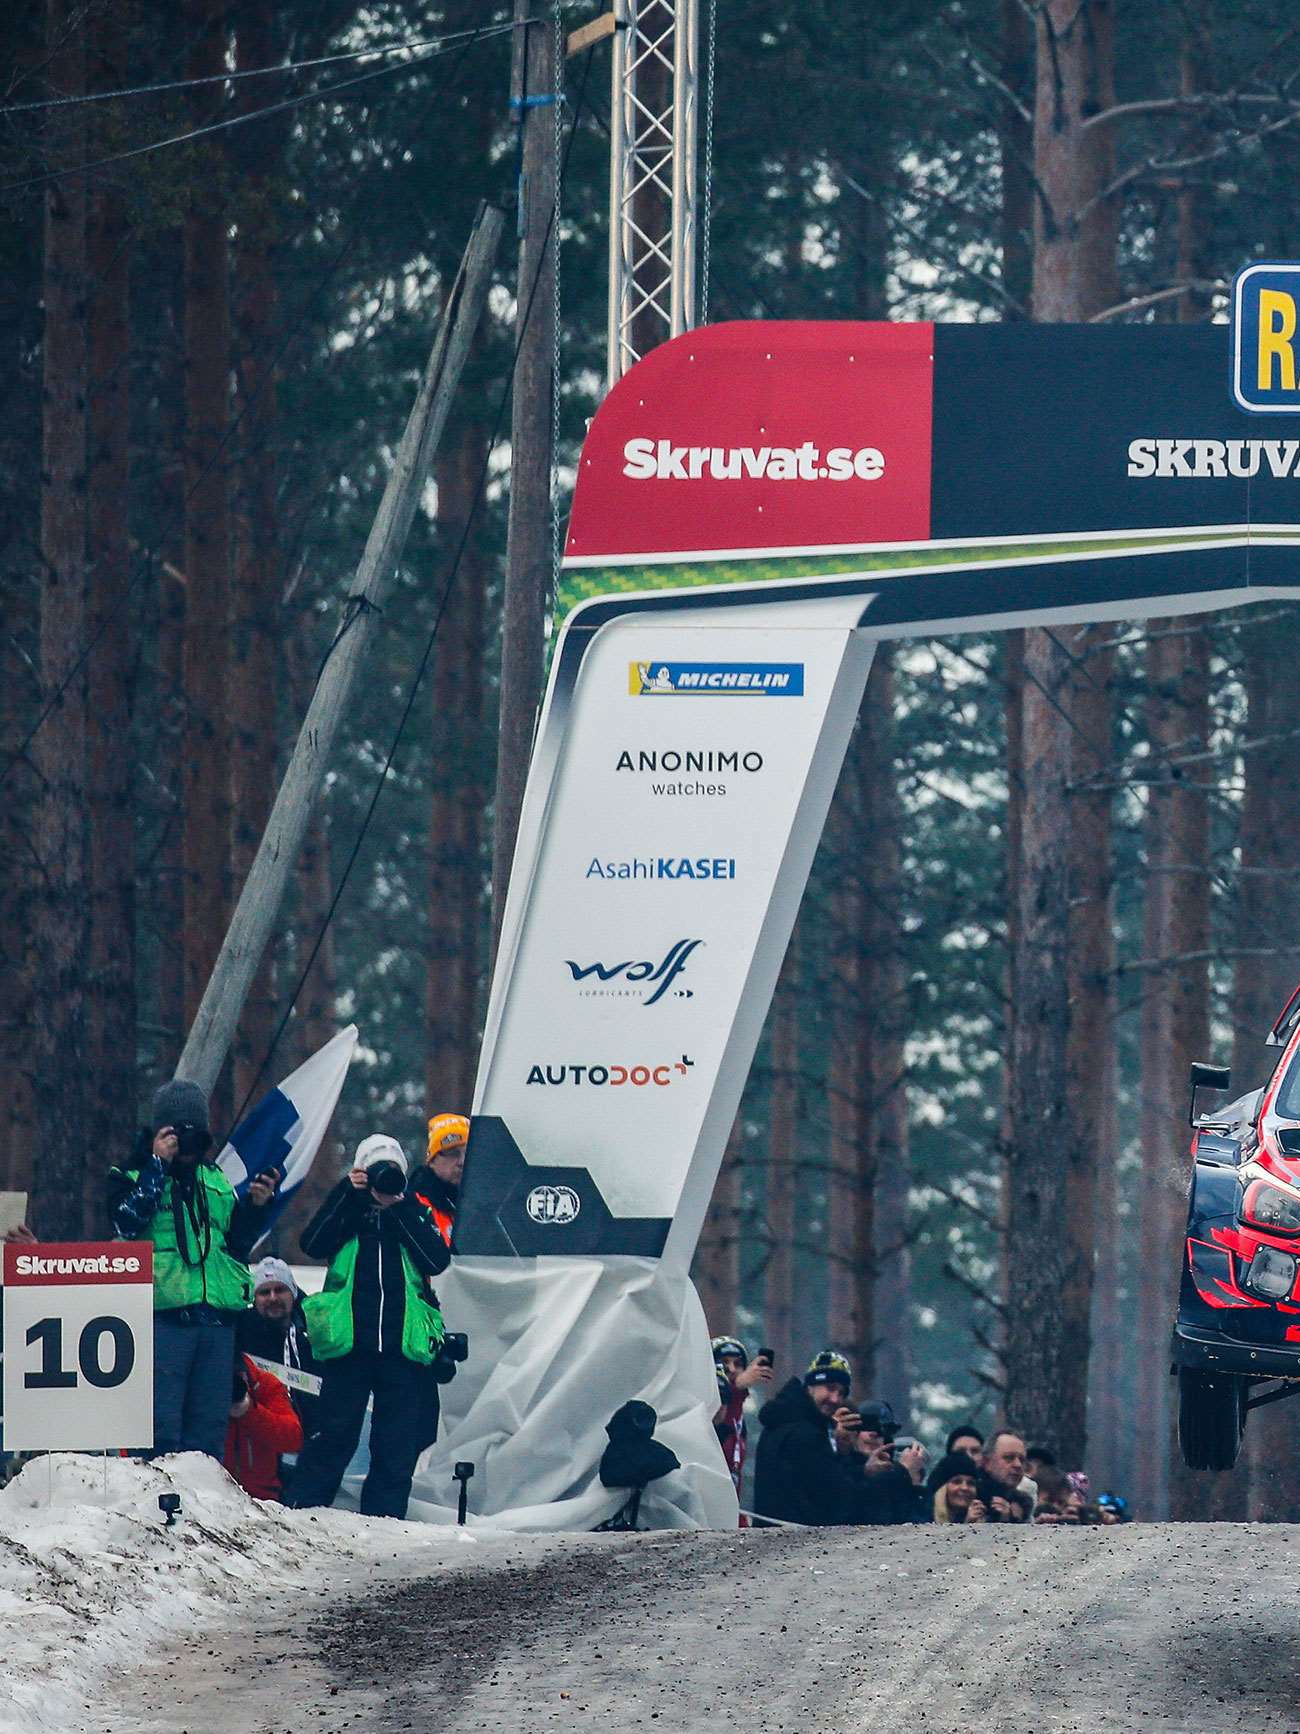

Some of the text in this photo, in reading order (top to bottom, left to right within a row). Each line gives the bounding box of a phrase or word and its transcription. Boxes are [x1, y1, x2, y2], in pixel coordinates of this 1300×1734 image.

[622, 438, 885, 482] Skruvat.se
[678, 672, 790, 688] MICHELIN
[616, 750, 764, 772] ANONIMO
[652, 781, 726, 796] watches
[526, 1064, 671, 1086] AUTODOC
[529, 1191, 577, 1219] FIA
[16, 1255, 140, 1275] Skruvat.se
[24, 1315, 136, 1389] 10
